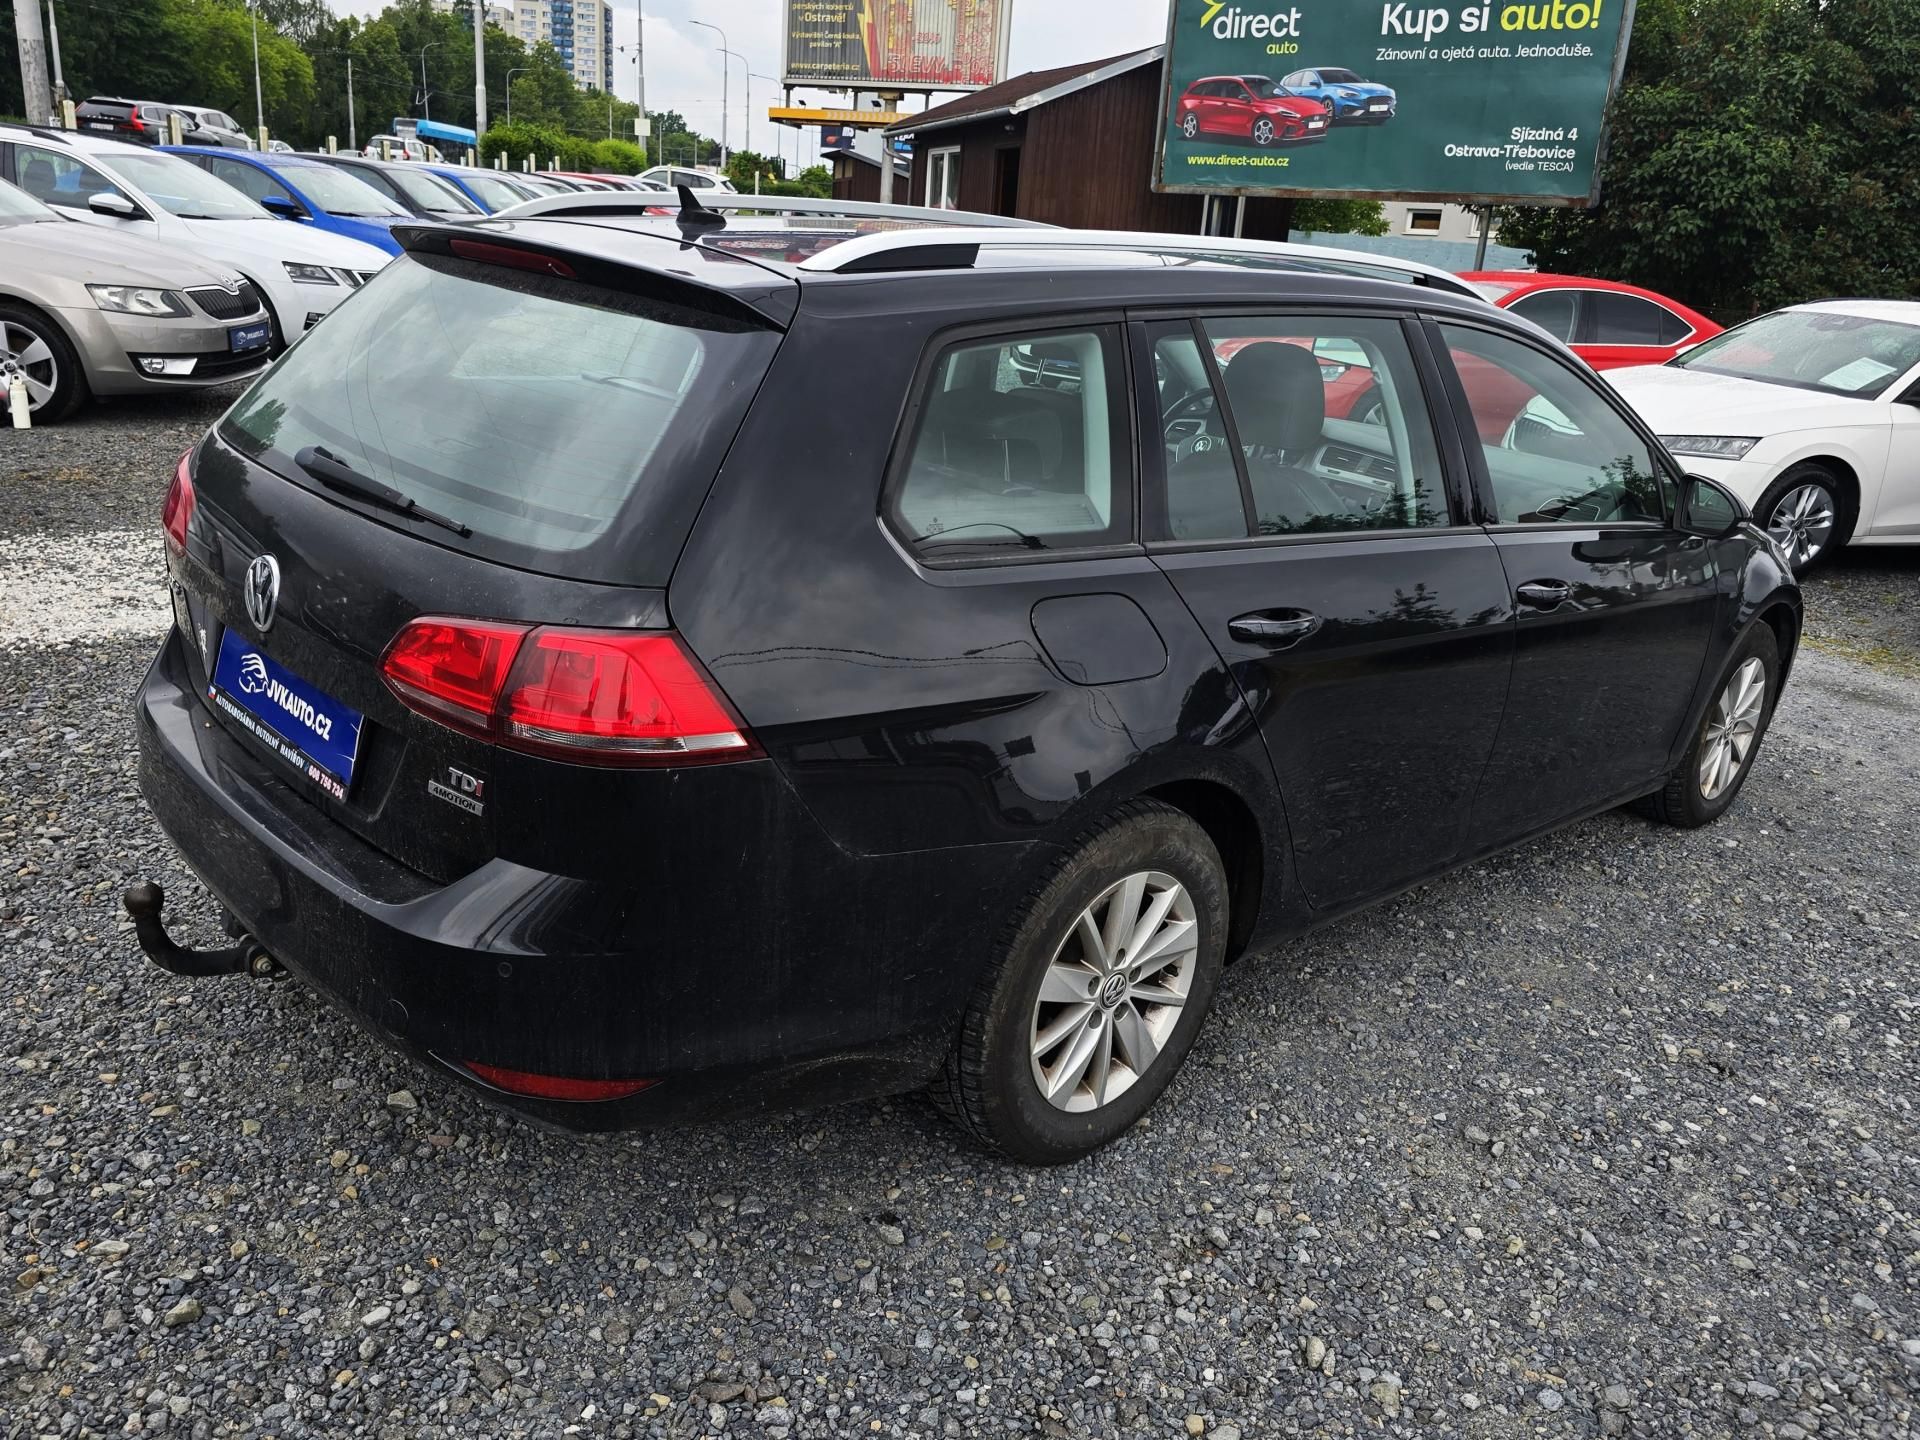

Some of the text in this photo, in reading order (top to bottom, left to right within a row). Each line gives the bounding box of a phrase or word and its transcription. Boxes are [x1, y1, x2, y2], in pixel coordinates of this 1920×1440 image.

[804, 12, 846, 23] Ostravě!
[1212, 7, 1302, 40] direct
[1381, 0, 1602, 42] Kup si auto!
[1265, 41, 1298, 55] auto
[1376, 43, 1594, 62] Zánovní a ojetá auta. Jednoduše.
[1510, 127, 1578, 143] Sjízdná 4
[1444, 143, 1576, 159] Ostrava-Třebovice
[1187, 154, 1289, 167] www.direct-auto.cz
[1505, 160, 1574, 173] (vedle TESCA)
[266, 679, 333, 741] JVKAUTO.CZ
[433, 787, 476, 811] 4MOTION
